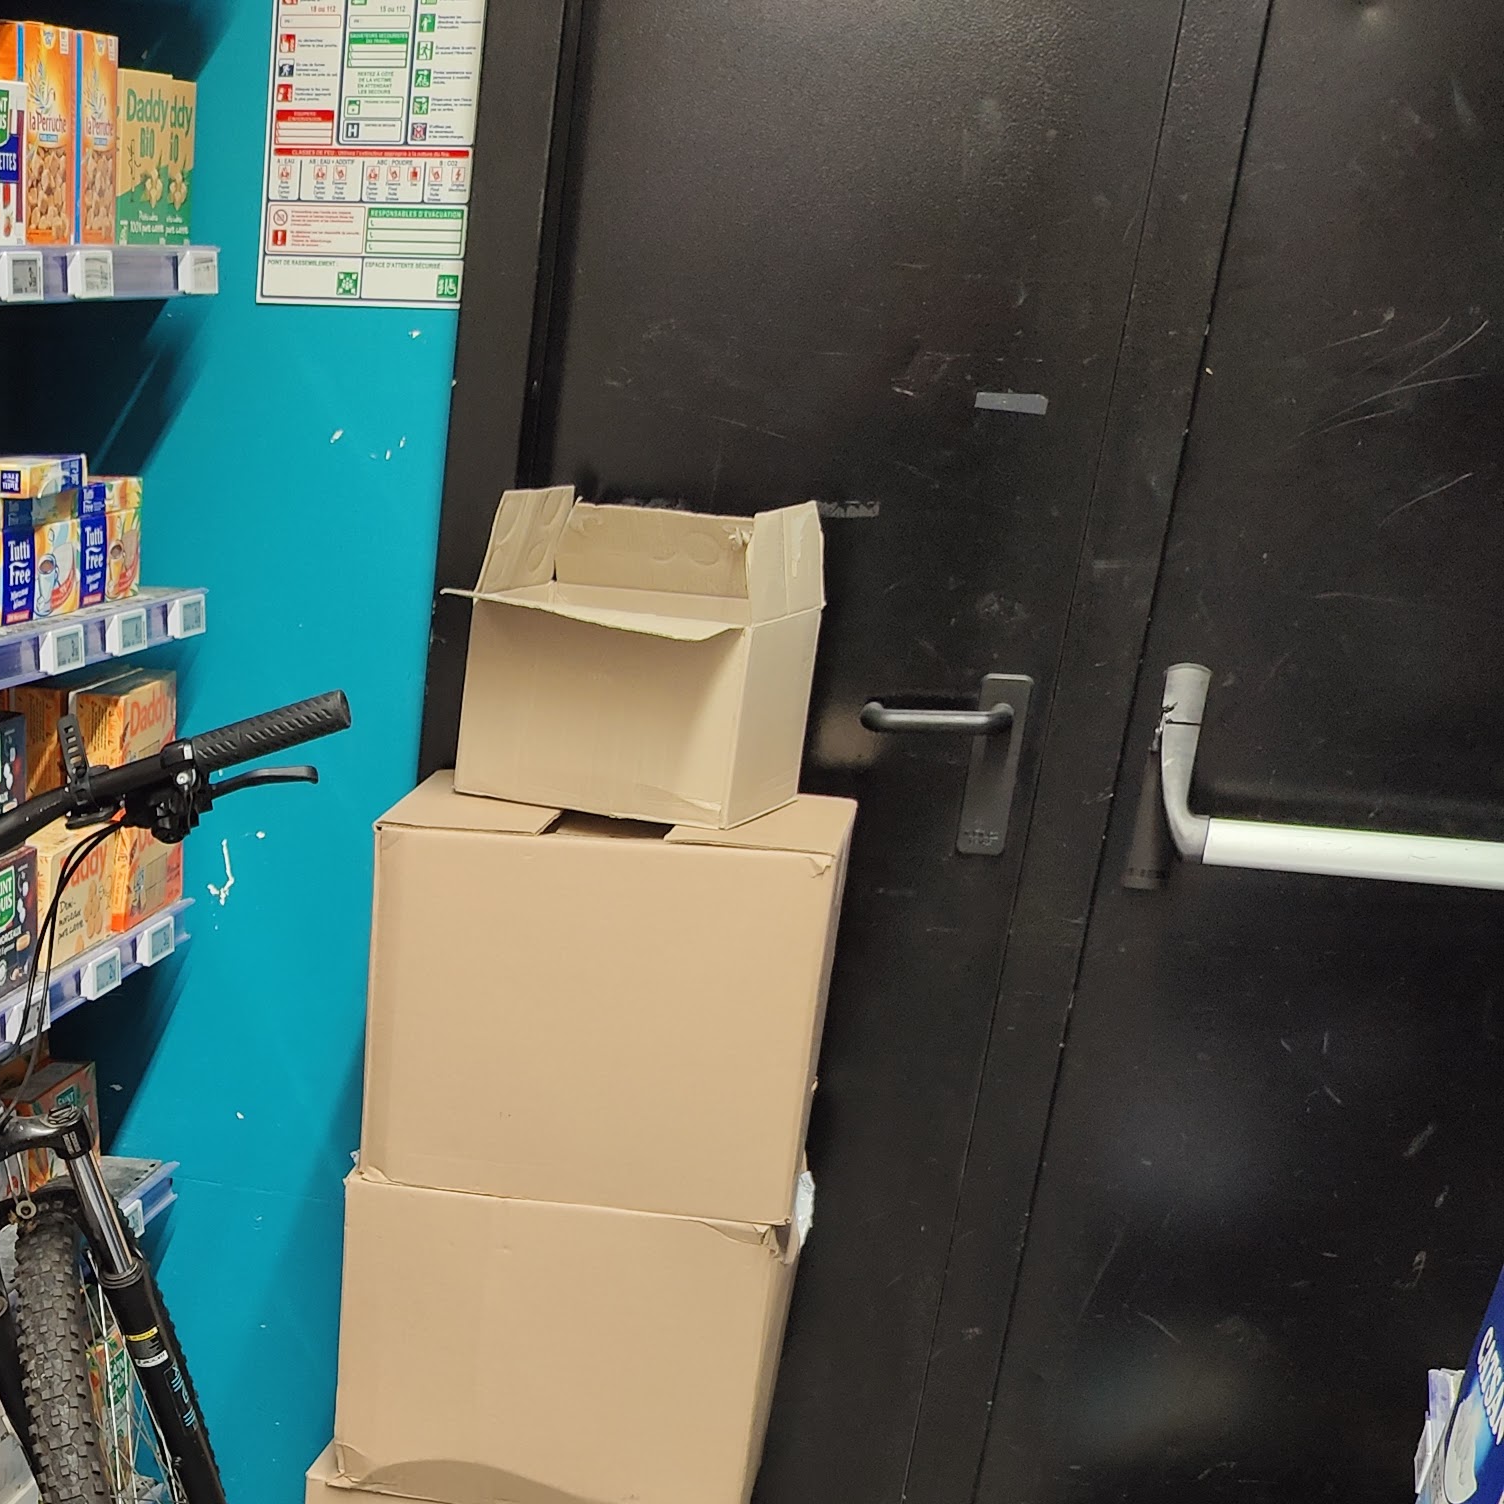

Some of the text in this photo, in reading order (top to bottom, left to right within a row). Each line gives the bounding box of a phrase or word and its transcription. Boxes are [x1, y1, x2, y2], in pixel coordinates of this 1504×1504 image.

[126, 88, 168, 132] Daddy
[36, 111, 67, 133] Perruche
[8, 540, 30, 563] Tutti
[9, 563, 31, 585] Free
